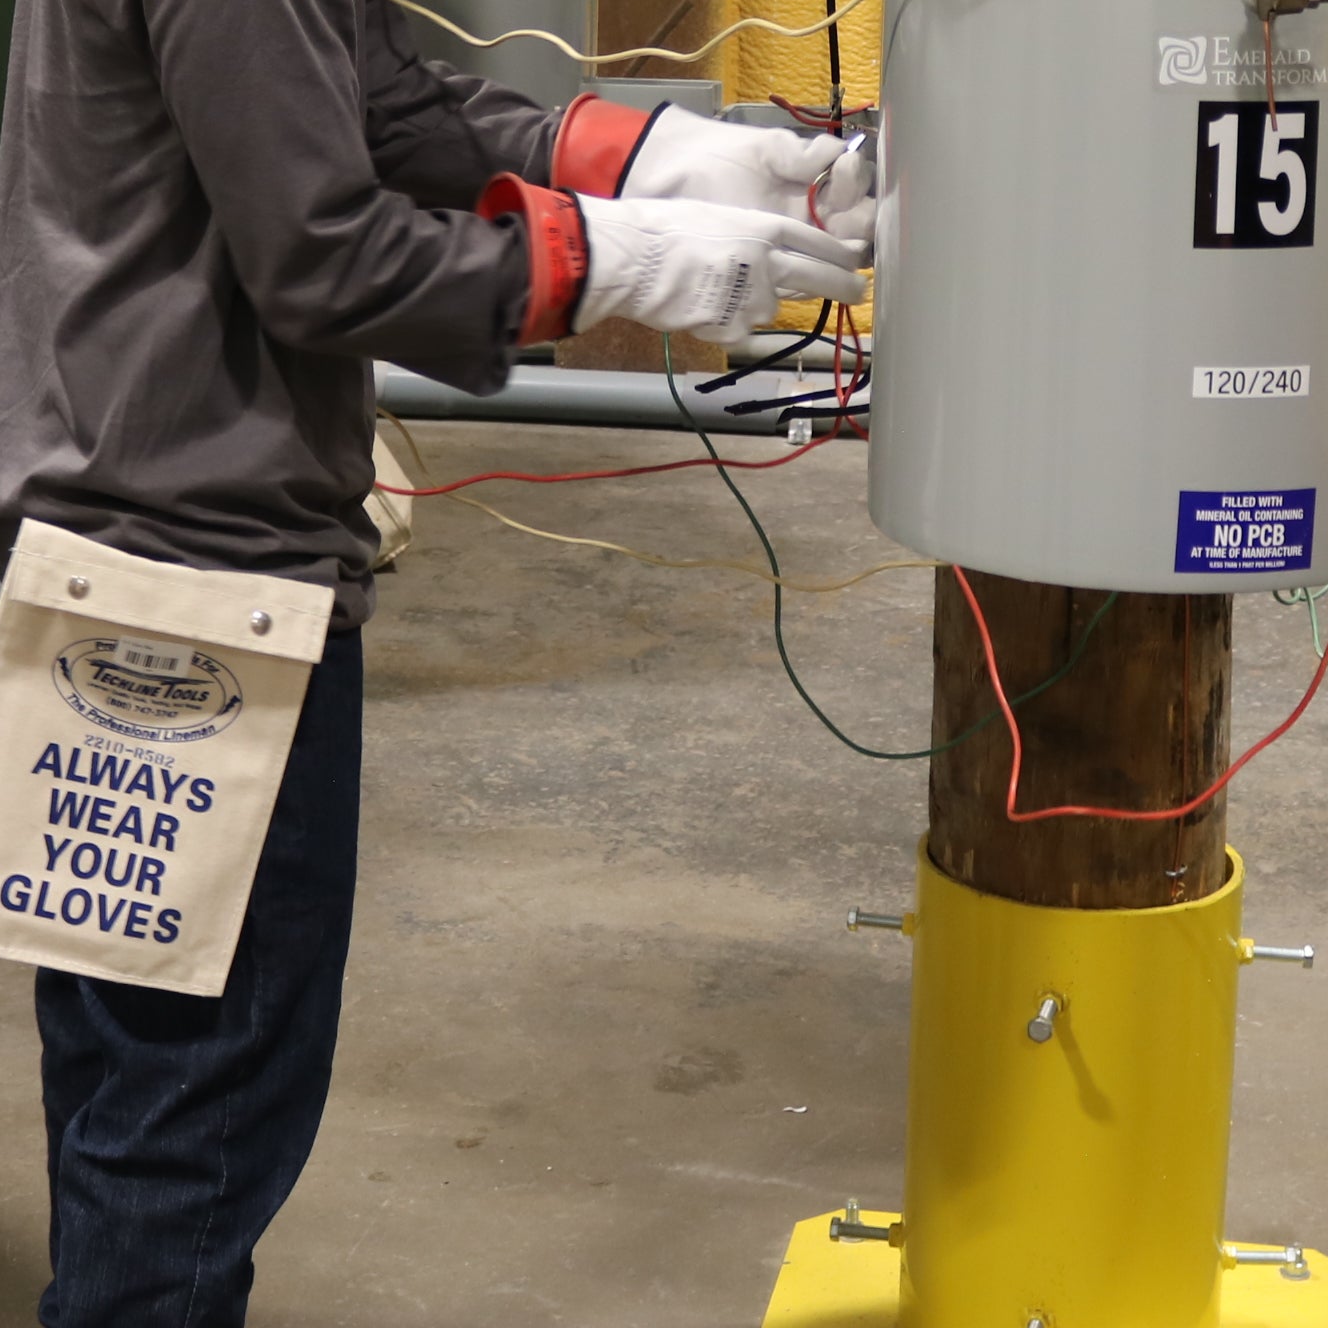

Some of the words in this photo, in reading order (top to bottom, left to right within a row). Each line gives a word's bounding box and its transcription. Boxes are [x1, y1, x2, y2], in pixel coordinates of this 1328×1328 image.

[1208, 112, 1307, 236] 15
[1204, 369, 1302, 394] 120/240
[1196, 510, 1236, 522] MINERAL
[1238, 510, 1252, 521] OIL
[1255, 509, 1304, 521] CONTAINING
[1222, 496, 1256, 508] FILLED
[1258, 495, 1283, 507] WITH
[1190, 547, 1203, 558] AT
[1205, 547, 1226, 558] TIME
[1229, 547, 1240, 558] OF
[1242, 545, 1303, 558] MANUFACTURE
[1214, 524, 1242, 547] NO
[1247, 524, 1285, 547] PCB
[67, 692, 85, 711] The
[85, 708, 161, 740] Professional
[163, 725, 216, 741] Lineman
[31, 742, 216, 813] ALWAYS
[48, 787, 181, 852] WEAR
[43, 833, 167, 896] YOUR
[0, 874, 183, 944] GLOVES
